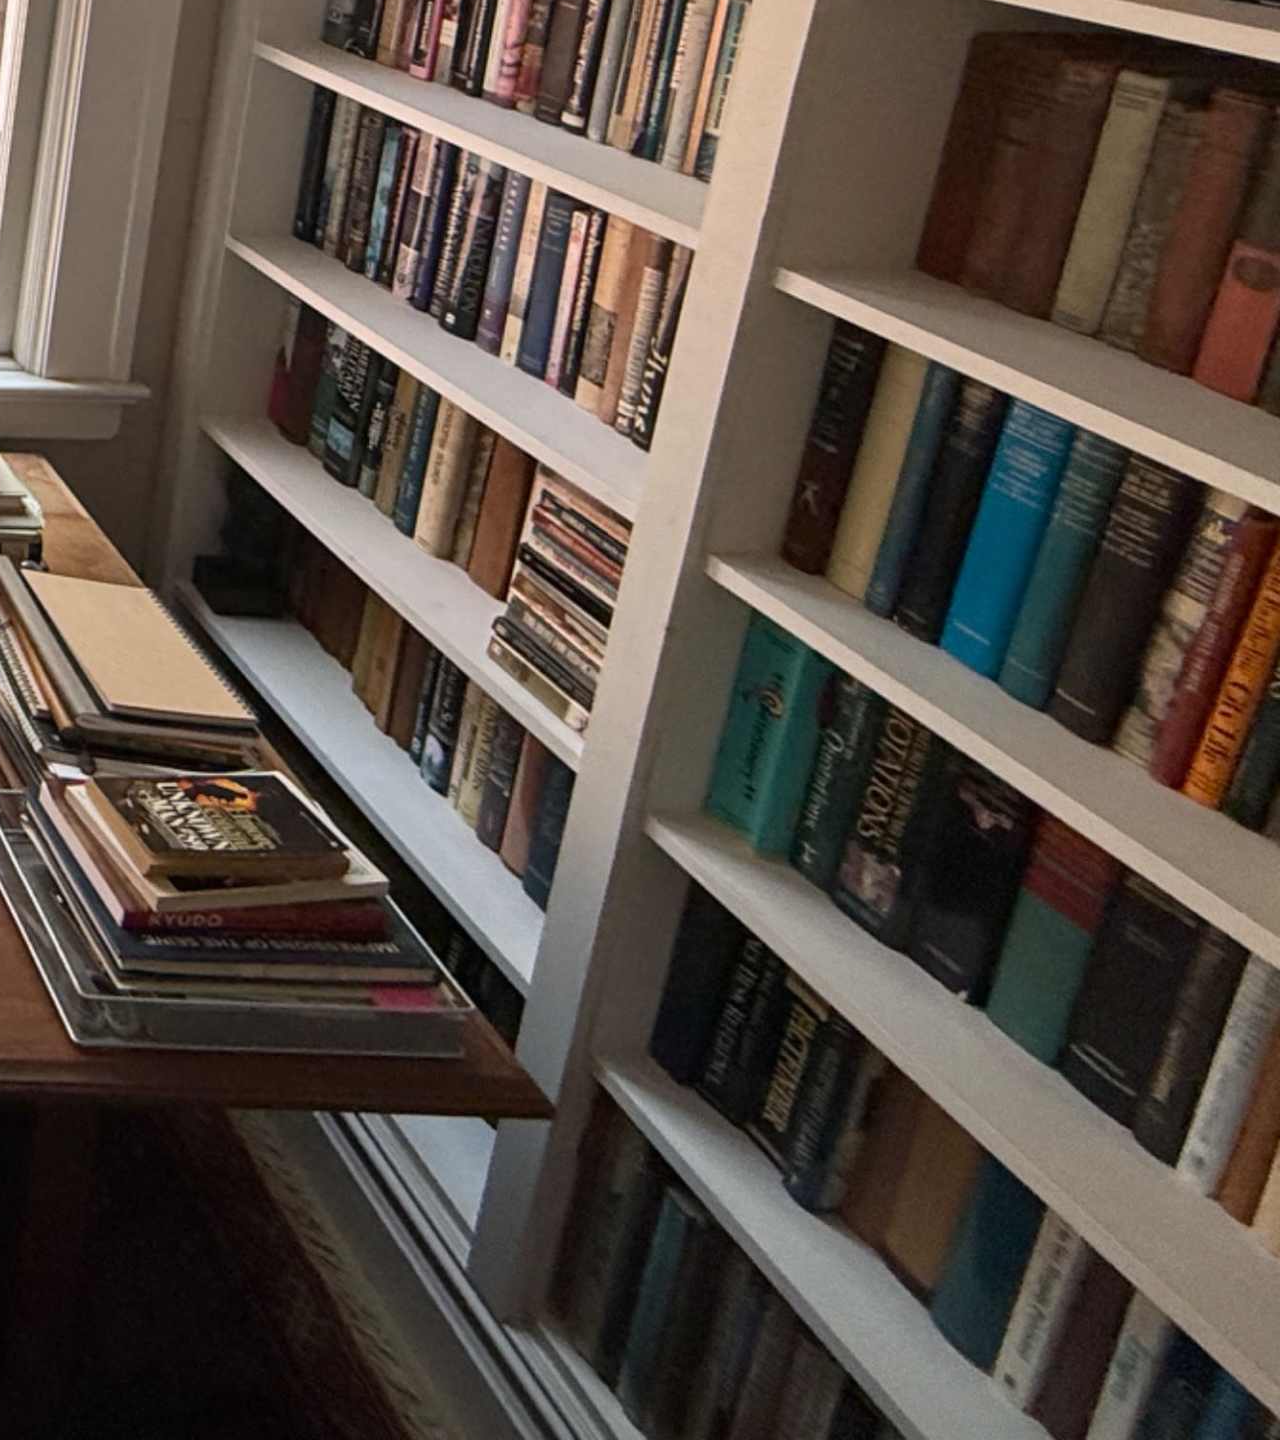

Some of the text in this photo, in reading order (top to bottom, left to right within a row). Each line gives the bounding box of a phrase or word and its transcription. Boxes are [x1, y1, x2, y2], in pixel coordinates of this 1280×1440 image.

[856, 709, 916, 838] OTATIONS
[148, 912, 224, 928] KYUDO
[141, 933, 199, 947] SEINE
[270, 938, 400, 954] IMPRESSIONS
